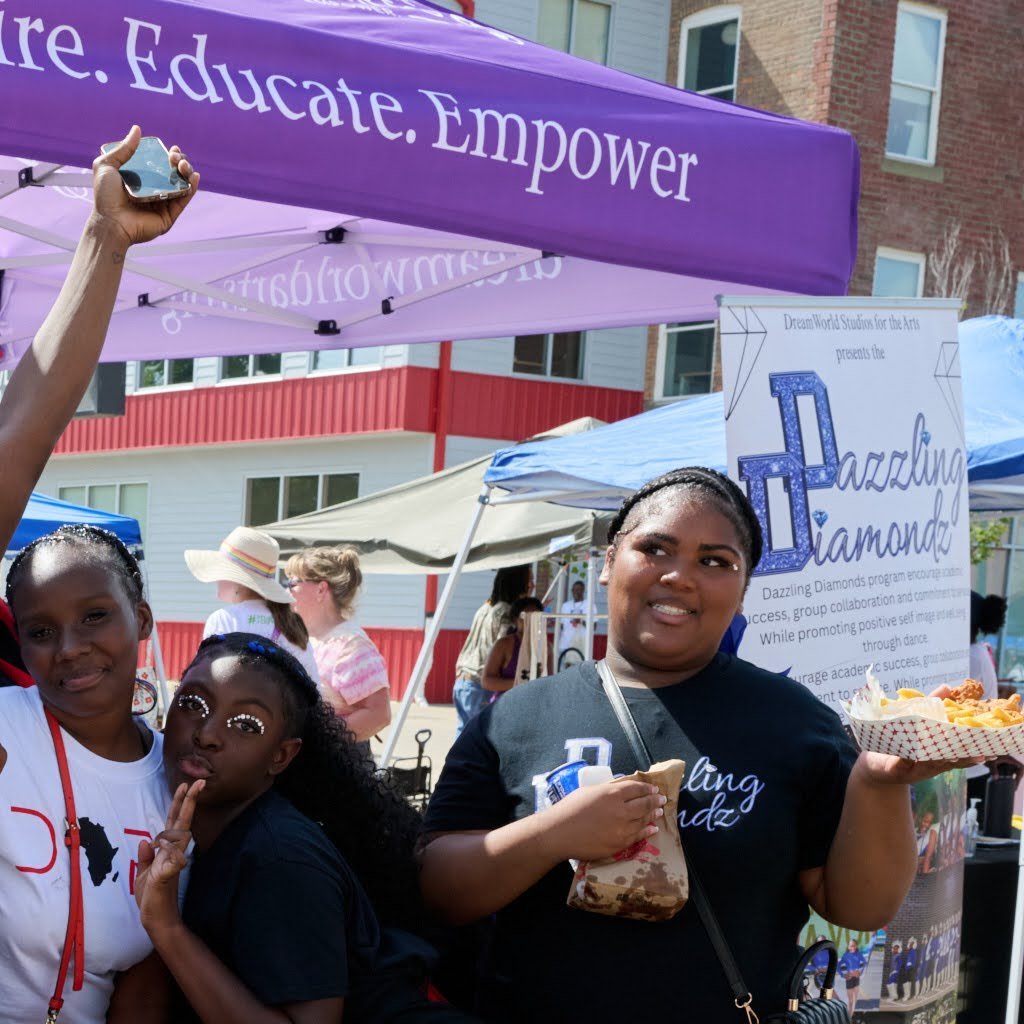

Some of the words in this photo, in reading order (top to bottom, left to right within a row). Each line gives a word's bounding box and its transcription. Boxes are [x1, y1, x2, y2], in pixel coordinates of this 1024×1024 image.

[123, 17, 417, 144] Educate.
[419, 89, 699, 203] Empower
[840, 313, 873, 330] Studios
[874, 313, 887, 330] for
[888, 313, 902, 330] the
[903, 314, 921, 331] Arts
[835, 346, 871, 364] presents
[871, 344, 885, 360] the
[768, 370, 965, 526] Dazzling
[738, 451, 953, 577] Diamondz
[762, 582, 812, 601] Dazzling
[814, 575, 866, 593] Diamonds
[868, 571, 906, 588] program
[793, 602, 827, 621] group
[830, 593, 894, 614] collaboration
[896, 592, 913, 603] and
[759, 630, 795, 646] While
[798, 621, 857, 644] promoting
[858, 615, 898, 634] positive
[898, 611, 914, 625] self
[862, 635, 902, 653] through
[903, 633, 929, 647] dance
[883, 656, 922, 672] success,
[838, 688, 850, 701] to
[894, 676, 919, 692] While
